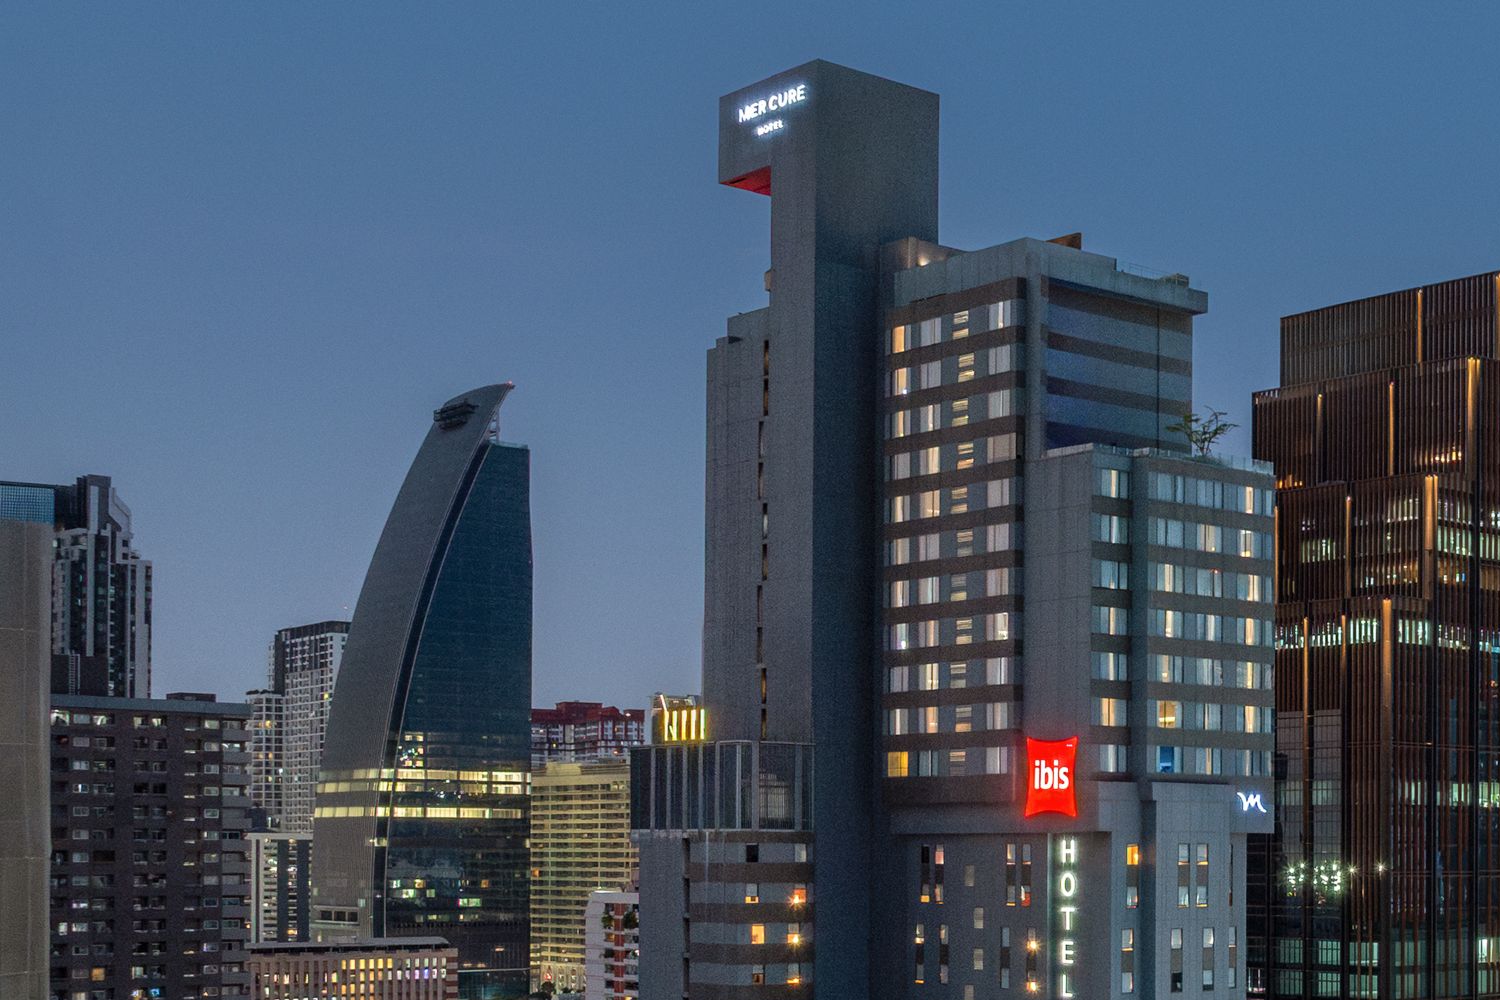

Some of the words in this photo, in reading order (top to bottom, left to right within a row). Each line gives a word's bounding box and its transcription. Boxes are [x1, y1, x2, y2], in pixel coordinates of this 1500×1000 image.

[738, 84, 806, 122] MERCURE
[1034, 760, 1069, 790] ibis
[1060, 839, 1076, 998] HOTEL
